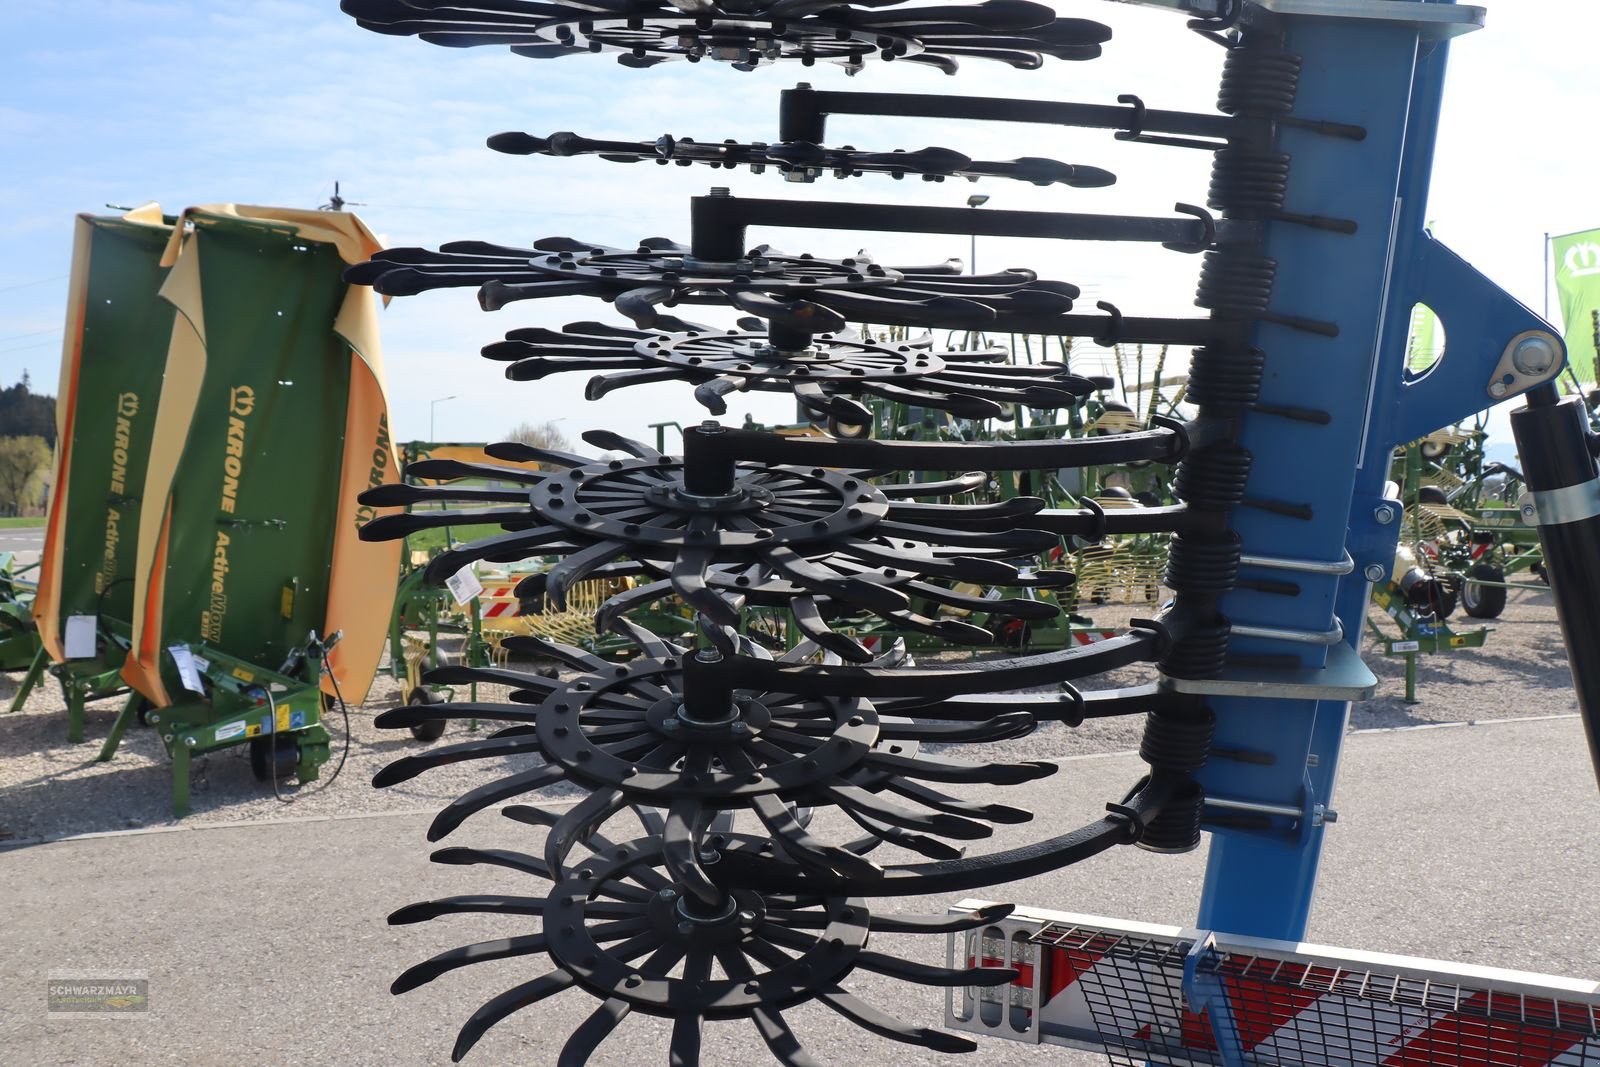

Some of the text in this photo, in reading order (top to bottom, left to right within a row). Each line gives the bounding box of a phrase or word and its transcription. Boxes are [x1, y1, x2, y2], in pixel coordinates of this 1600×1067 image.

[110, 418, 131, 495] KRONE
[367, 413, 389, 490] RON
[210, 416, 246, 643] KRONE ActiveMow
